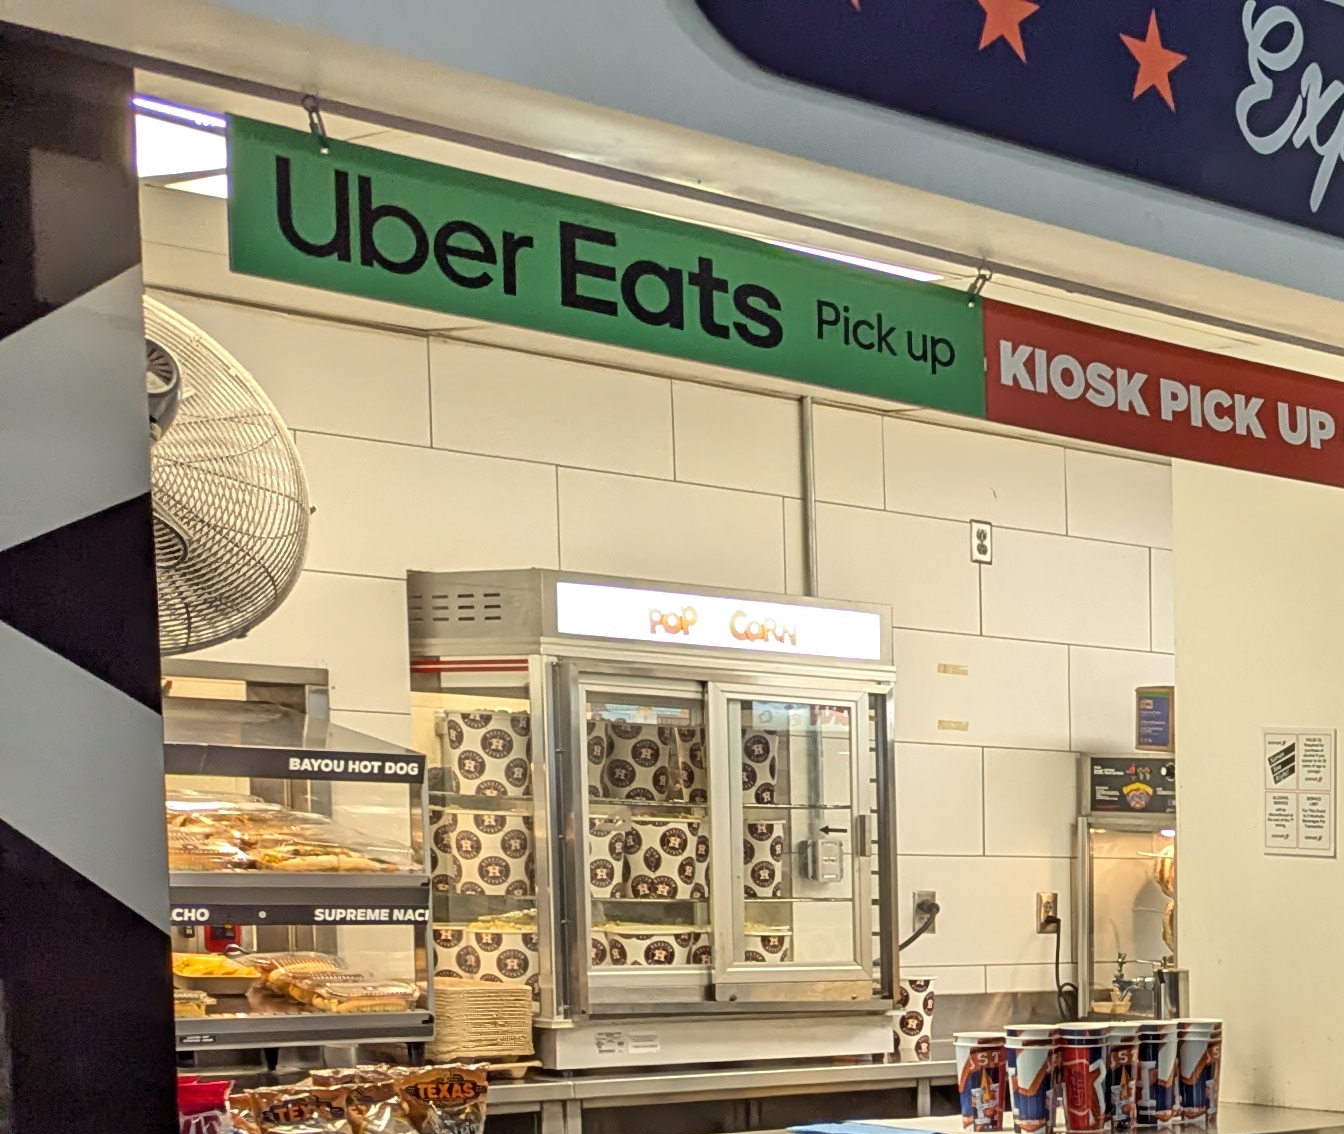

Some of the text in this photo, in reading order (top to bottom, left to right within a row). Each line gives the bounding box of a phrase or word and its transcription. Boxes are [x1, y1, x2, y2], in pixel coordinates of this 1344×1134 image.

[275, 154, 784, 350] Uber Eats
[815, 300, 955, 377] Pick up
[1000, 340, 1150, 416] KIOSK
[1160, 380, 1266, 441] PICK
[1279, 402, 1336, 450] UP
[649, 605, 698, 635] POP
[288, 757, 419, 776] BAYOU HOT DOG
[170, 908, 210, 921] CHO
[313, 908, 389, 922] SUPREME
[417, 1083, 475, 1099] TEXAS
